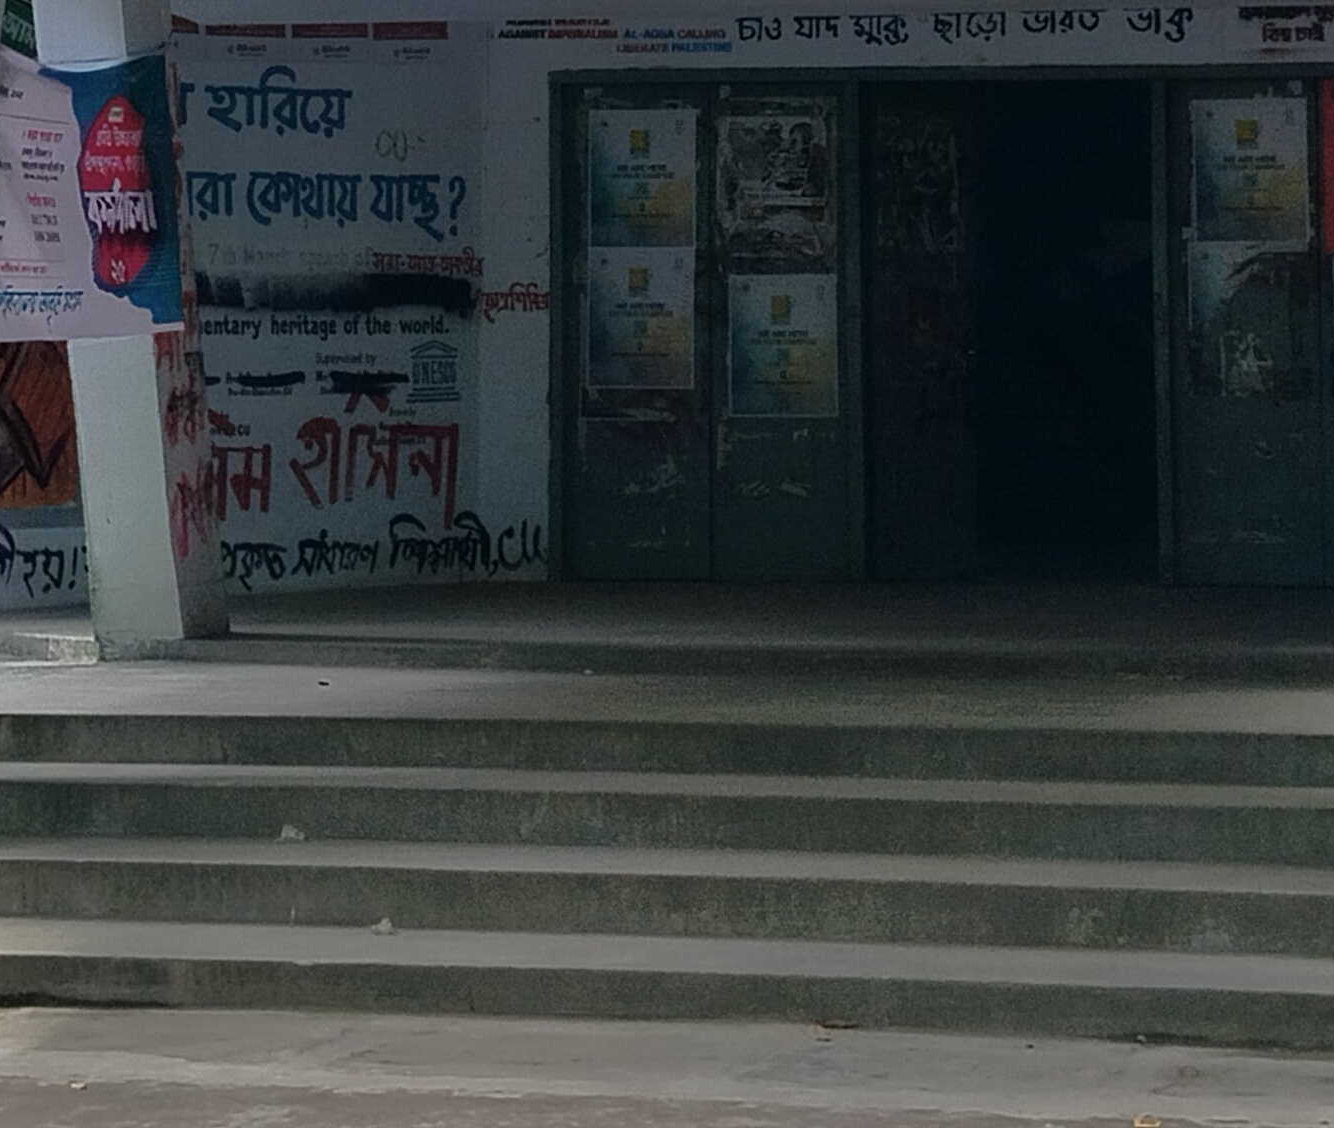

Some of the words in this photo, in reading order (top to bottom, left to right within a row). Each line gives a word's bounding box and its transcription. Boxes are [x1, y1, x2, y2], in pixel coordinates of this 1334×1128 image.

[204, 65, 352, 137] হারিয়ে
[246, 172, 362, 228] কোথায়
[270, 315, 337, 340] heritage
[343, 315, 362, 335] of
[366, 314, 392, 335] the
[399, 315, 450, 335] world.
